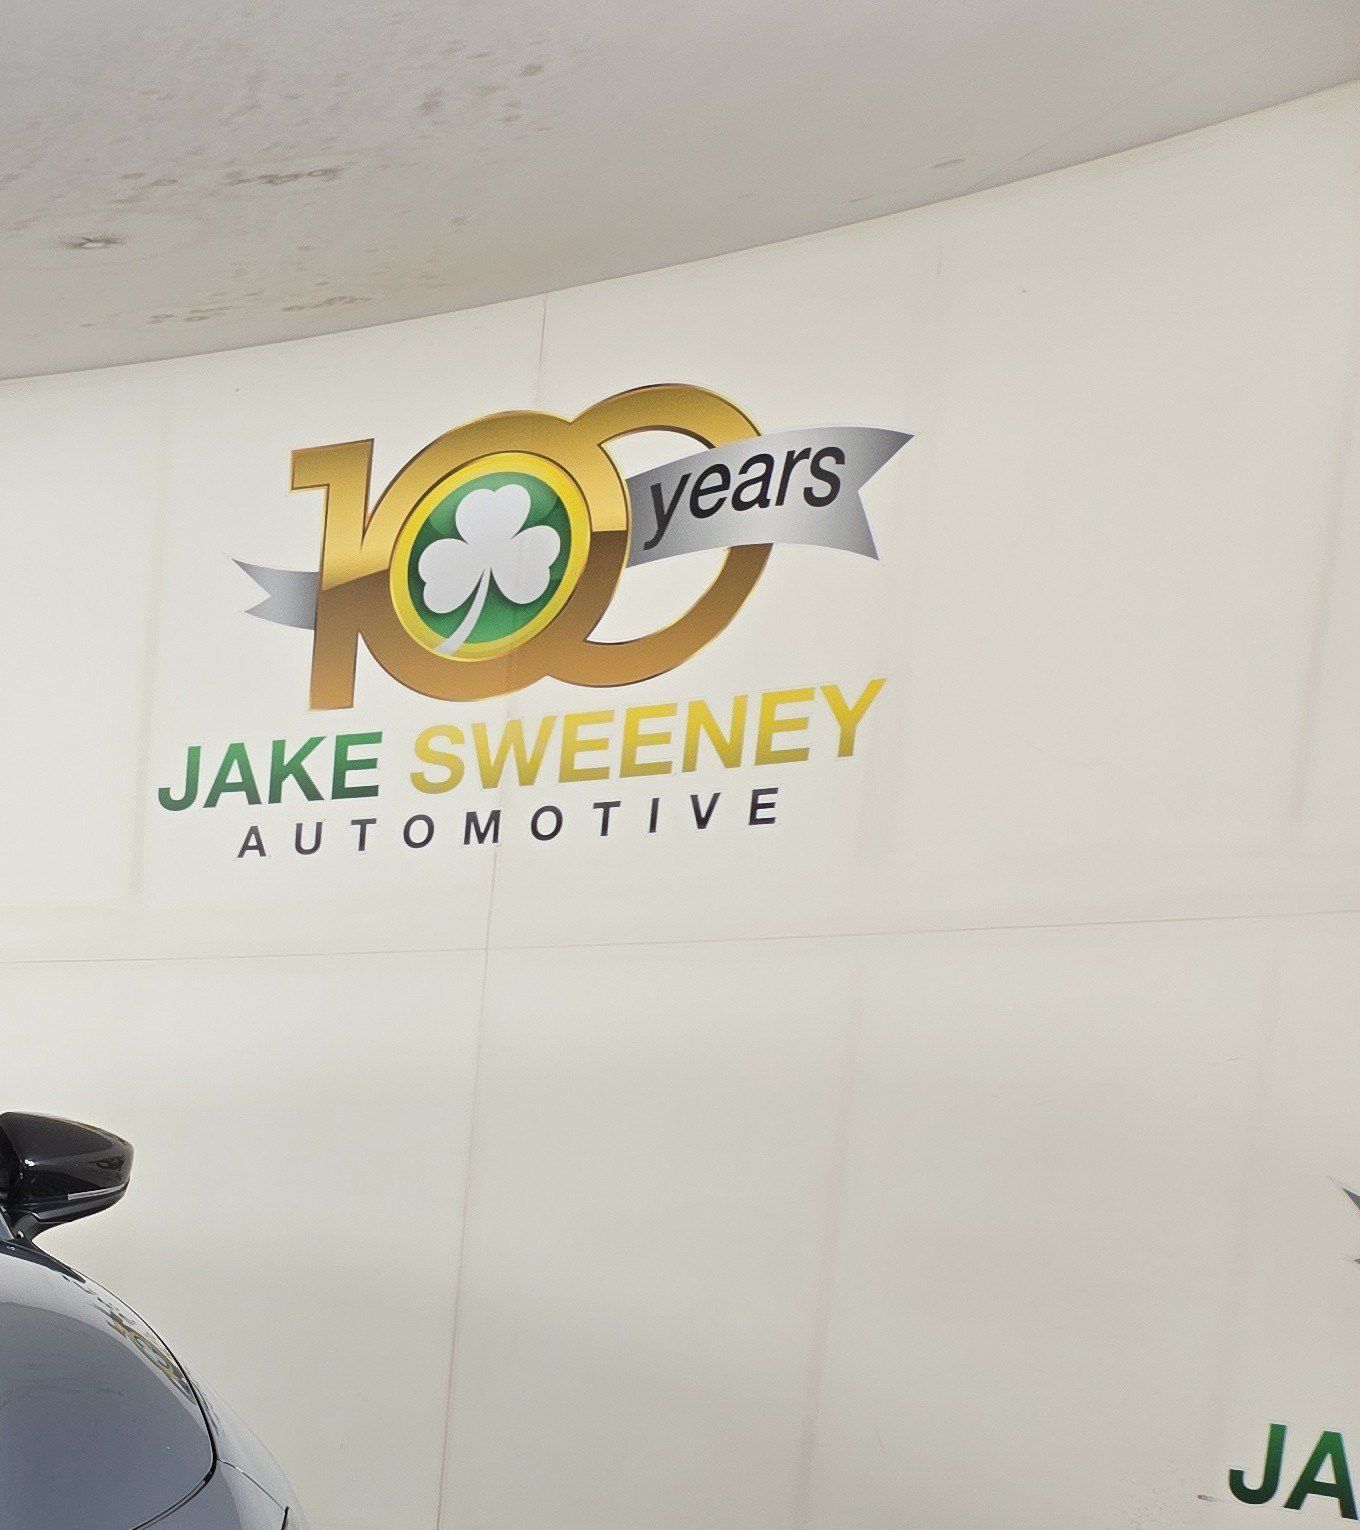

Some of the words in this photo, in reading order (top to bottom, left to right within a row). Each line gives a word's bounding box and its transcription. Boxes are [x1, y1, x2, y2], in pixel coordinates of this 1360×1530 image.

[643, 446, 846, 550] years
[158, 730, 384, 812] JAKE
[409, 679, 887, 795] SWEENEY
[236, 787, 779, 860] AUTOMOTIVE
